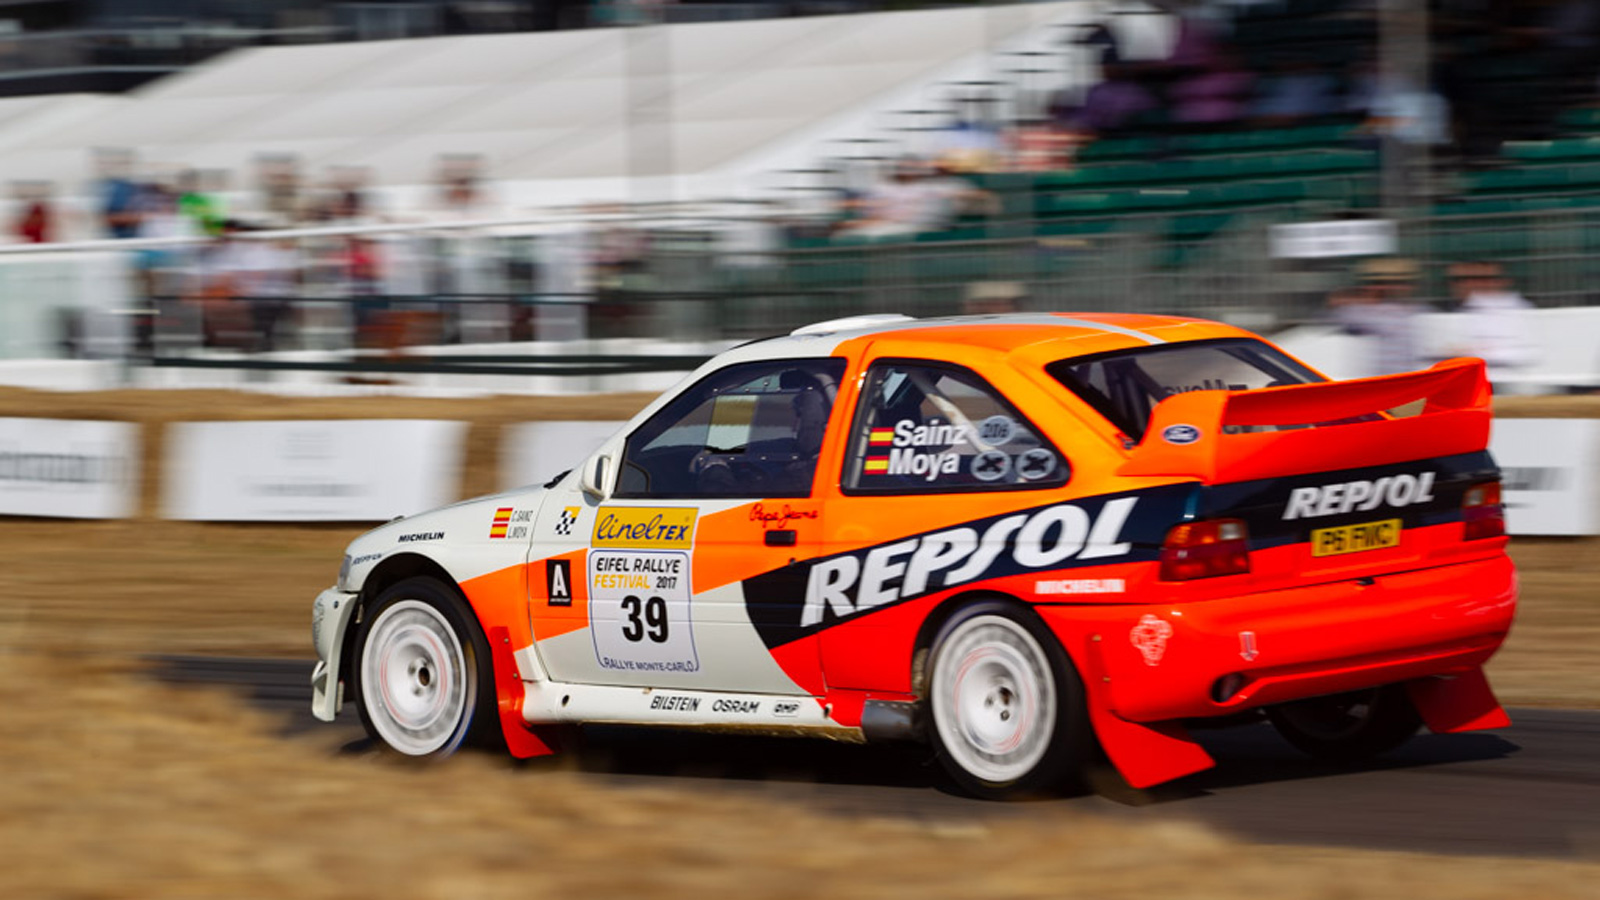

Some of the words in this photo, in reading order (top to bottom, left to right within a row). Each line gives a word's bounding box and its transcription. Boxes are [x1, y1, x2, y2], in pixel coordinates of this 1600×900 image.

[893, 419, 968, 447] Sainz
[888, 448, 960, 481] Moya
[1281, 471, 1436, 520] REPSOL
[397, 531, 445, 543] MICHELIN
[596, 557, 629, 572] EIFEL
[633, 558, 681, 573] RALLYE
[800, 497, 1140, 627] REPSOL
[552, 564, 568, 597] A
[594, 574, 651, 589] FESTIVAL
[656, 576, 678, 589] 2017
[621, 594, 669, 643] 39
[603, 657, 635, 670] RALLYE
[635, 660, 694, 673] MONTE-CARLO
[650, 696, 701, 711] BILSTEIN
[712, 699, 760, 713] OSRAM
